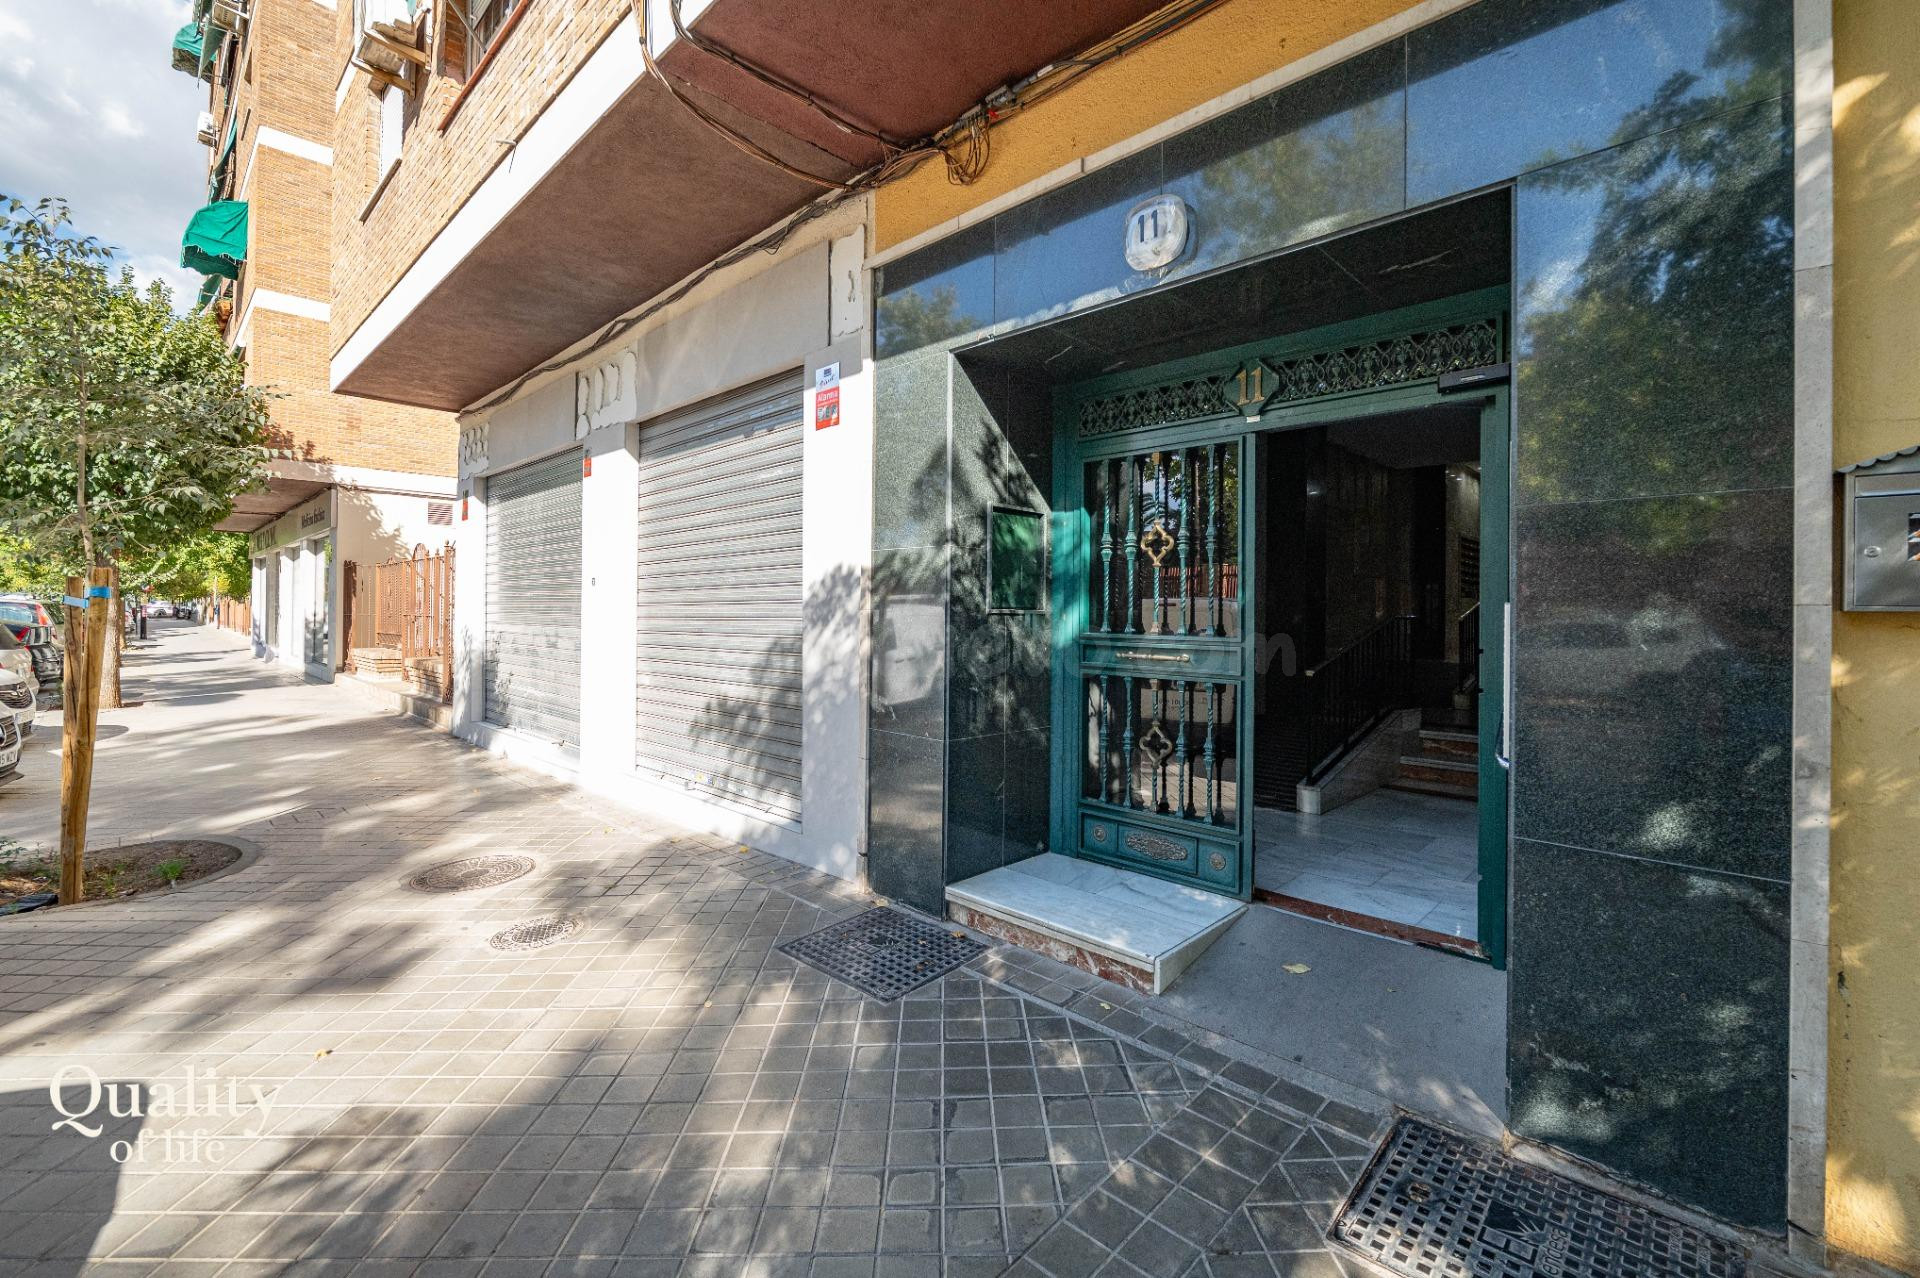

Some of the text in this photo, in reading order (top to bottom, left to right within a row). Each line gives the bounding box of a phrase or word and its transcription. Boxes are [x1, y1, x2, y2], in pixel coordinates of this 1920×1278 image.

[1138, 209, 1158, 243] 11
[1236, 366, 1265, 406] 11
[1542, 1227, 1569, 1276] endesa
